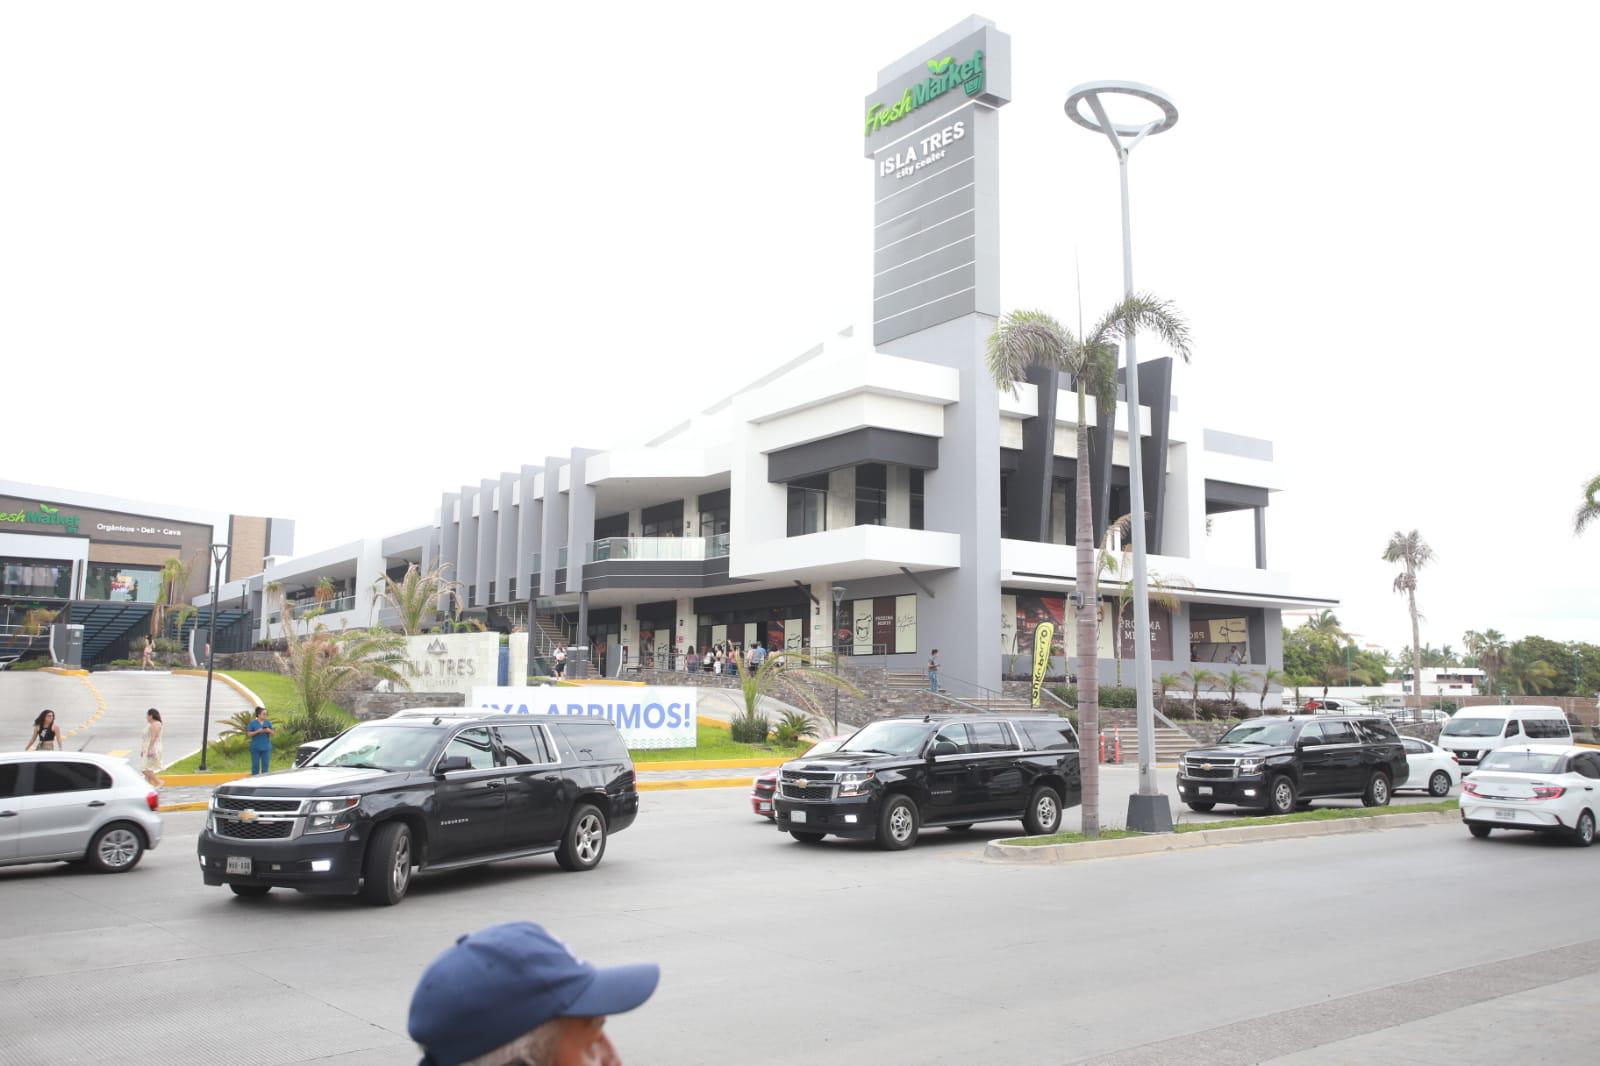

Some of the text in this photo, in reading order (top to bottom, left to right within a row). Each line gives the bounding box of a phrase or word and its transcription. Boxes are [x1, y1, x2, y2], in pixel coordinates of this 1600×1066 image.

[864, 50, 983, 136] Fresh Market
[880, 121, 964, 177] ISLA TRES
[896, 150, 946, 179] city center
[140, 526, 155, 534] Deli
[162, 528, 181, 536] Cava
[438, 658, 476, 676] TRES
